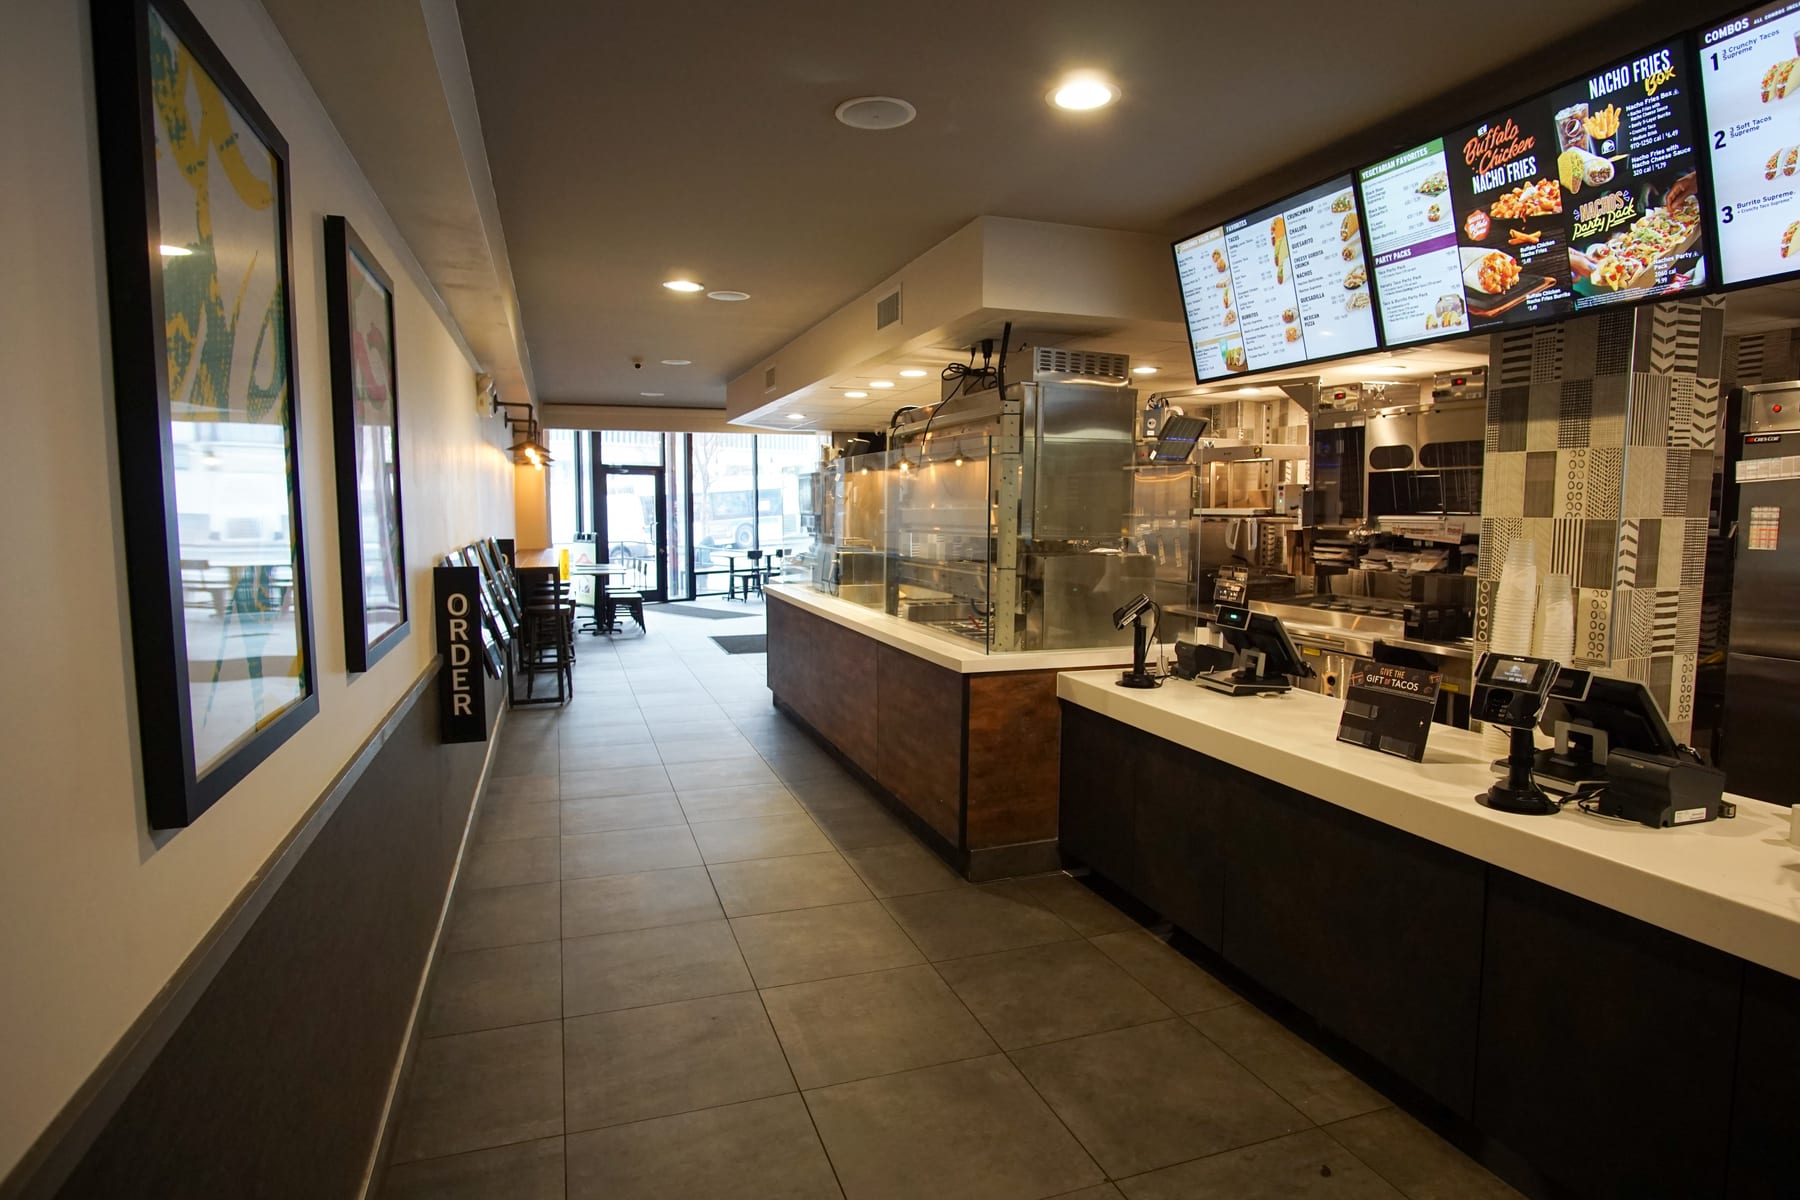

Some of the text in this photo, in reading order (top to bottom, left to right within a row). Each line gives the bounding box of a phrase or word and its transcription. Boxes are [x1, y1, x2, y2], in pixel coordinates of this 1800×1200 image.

[1704, 17, 1750, 44] COMBOS
[1728, 37, 1757, 53] Crunchy
[1759, 29, 1780, 41] Tacos
[1710, 52, 1719, 71] 1
[1722, 45, 1753, 61] Supreme
[1588, 48, 1671, 100] NACHO FRIES
[1644, 65, 1676, 97] Box
[1625, 90, 1673, 112] Nacho Fries Box
[1729, 125, 1760, 139] Supreme
[1736, 121, 1751, 132] Soft
[1752, 115, 1772, 126] Tacos
[1463, 118, 1520, 166] Buffalo
[1653, 134, 1662, 142] cal
[1713, 129, 1727, 151] 2
[1479, 135, 1536, 175] Chicken
[1631, 143, 1680, 164] Nacho Fries with
[1631, 147, 1692, 170] Nacho Cheese Sauce
[1361, 159, 1396, 180] VEGETARIAN
[1396, 147, 1429, 167] FAVORITES
[1633, 168, 1643, 177] 320
[1643, 165, 1652, 173] cal
[1472, 166, 1506, 195] NACHO
[1506, 155, 1538, 184] FRIES
[1579, 190, 1625, 223] NACHOS
[1737, 190, 1794, 209] Burrito Supreme
[1286, 205, 1314, 221] CRUNCHWRAP
[1721, 205, 1734, 224] 3
[1228, 234, 1240, 243] TACOS
[1289, 224, 1307, 236] CHALUPA
[1291, 237, 1314, 250] QUESARITO
[1294, 260, 1310, 270] CRUNCH
[1375, 248, 1412, 265] PARTY PACKS
[1653, 251, 1693, 265] Nachos Party
[1296, 269, 1312, 279] NACHOS
[1654, 262, 1668, 271] Pack
[1668, 267, 1677, 275] cal
[1300, 291, 1325, 304] QUESADILLA
[1241, 311, 1259, 321] BURRITOS
[1303, 313, 1320, 321] MEXICAN
[1304, 320, 1316, 328] PIZZA
[446, 592, 473, 717] ORDER
[1379, 667, 1406, 680] GIVE THE
[1366, 673, 1385, 685] GIFT
[1391, 678, 1420, 692] TACOS
